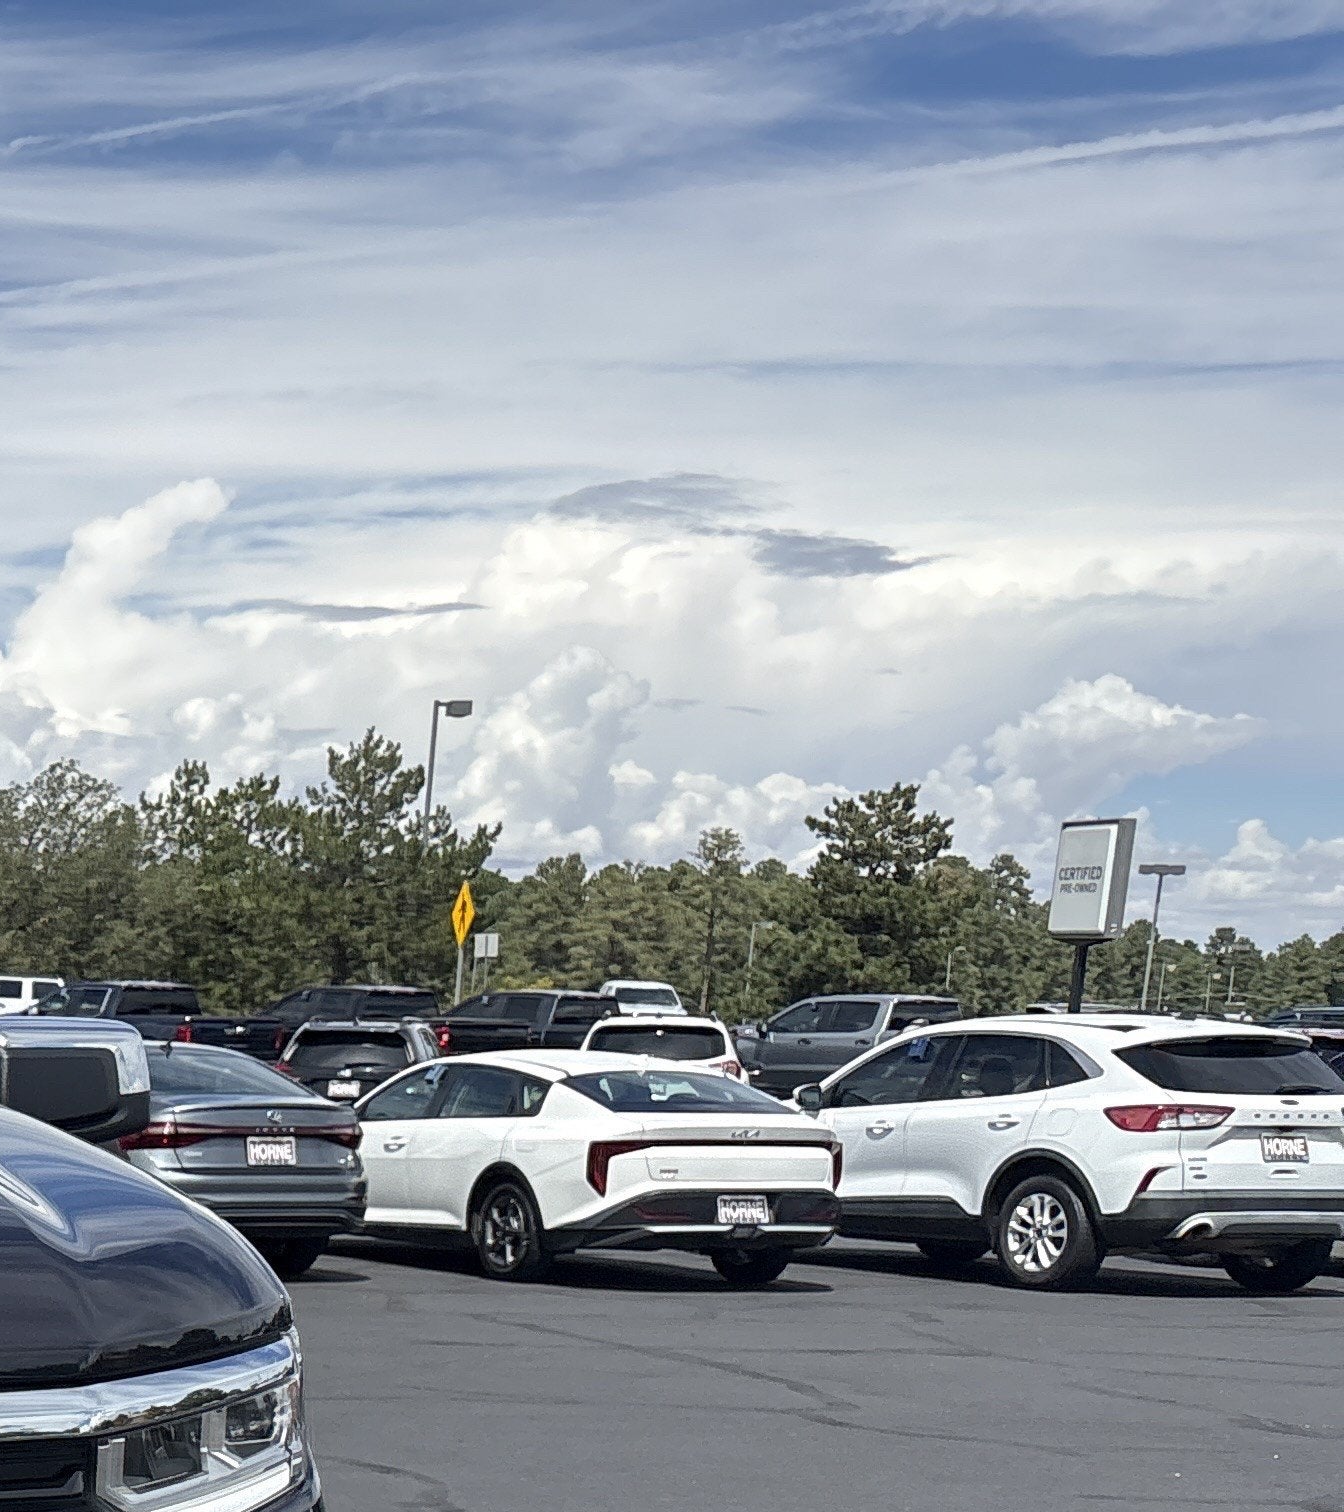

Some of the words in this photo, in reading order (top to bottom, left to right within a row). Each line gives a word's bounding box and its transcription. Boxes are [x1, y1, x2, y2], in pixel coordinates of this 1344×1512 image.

[1059, 866, 1102, 881] CERTIFIED
[1060, 883, 1097, 893] PRE-OWNED
[249, 1143, 293, 1161] HORNE
[1262, 1137, 1306, 1156] HORNE
[720, 1201, 765, 1220] HORNE
